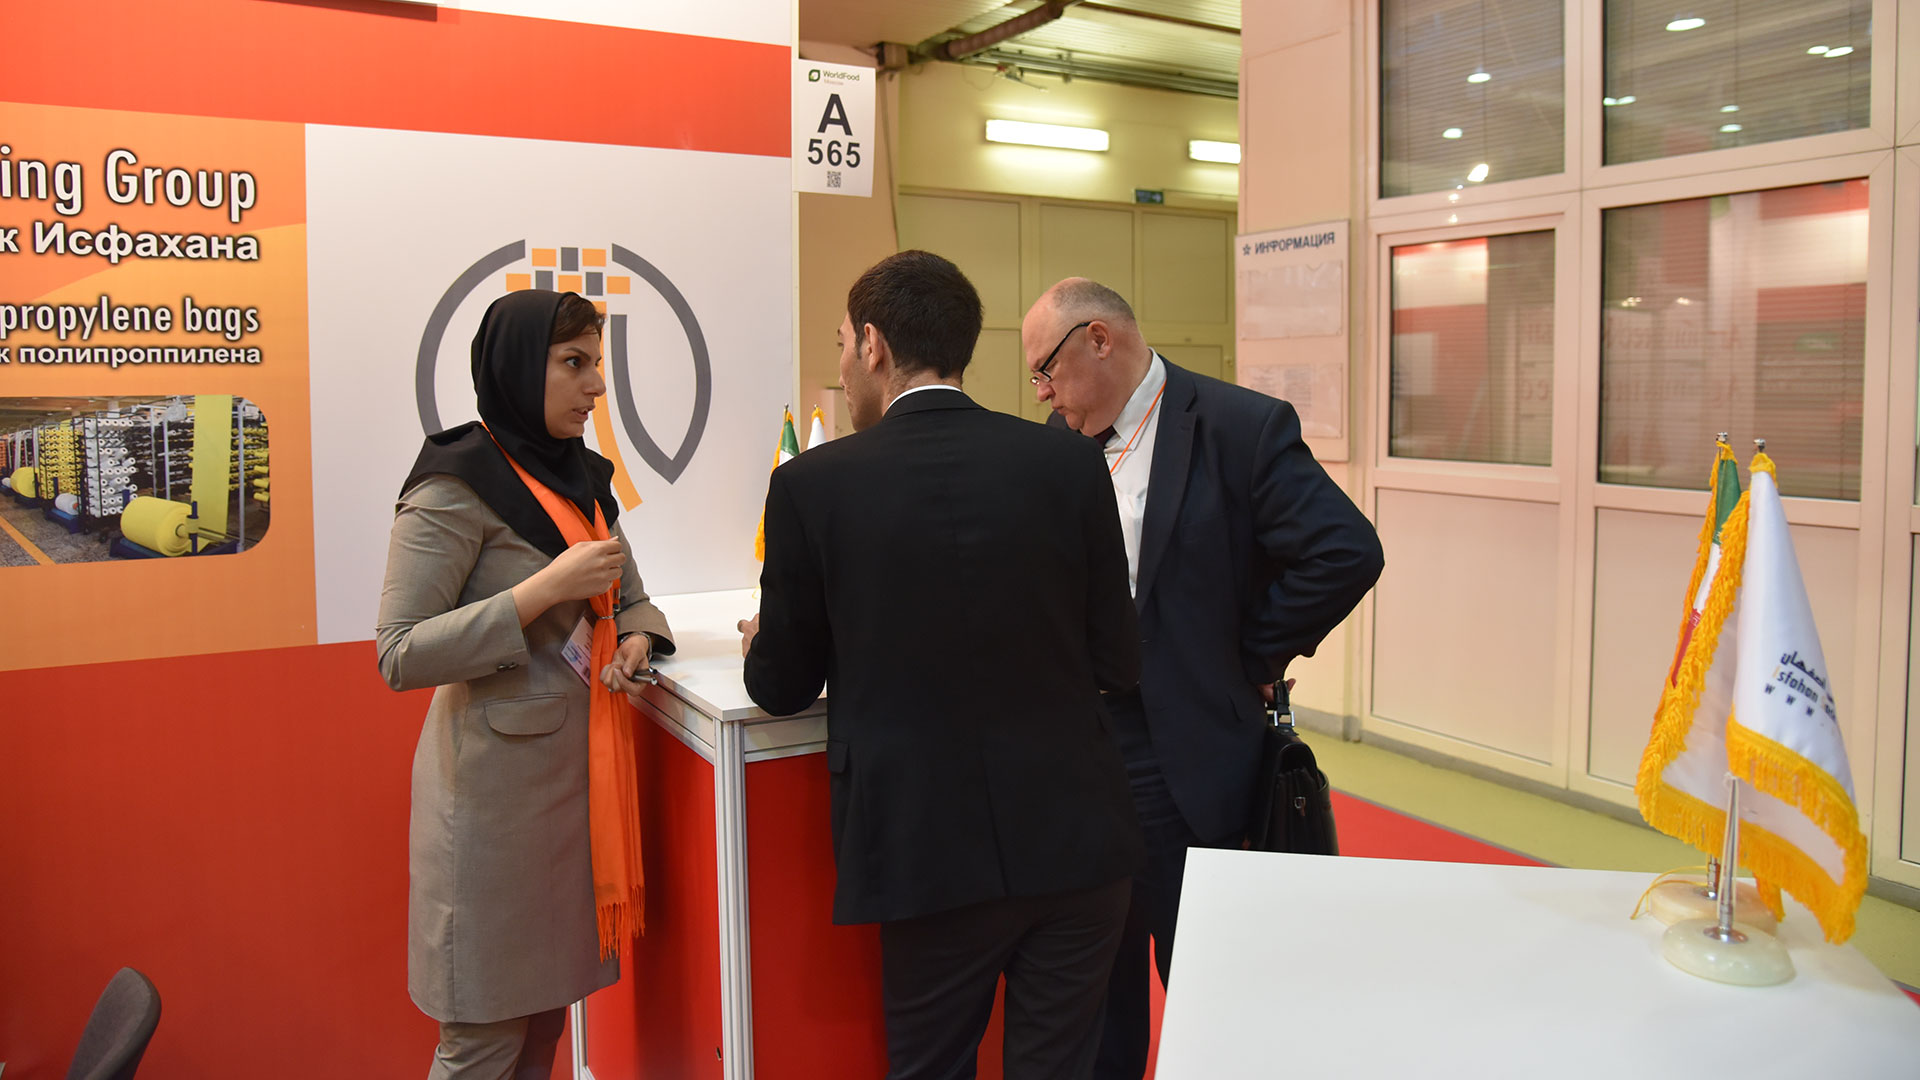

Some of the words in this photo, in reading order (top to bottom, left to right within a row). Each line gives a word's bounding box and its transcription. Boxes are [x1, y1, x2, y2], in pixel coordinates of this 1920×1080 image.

[823, 70, 860, 81] WorldFood
[817, 93, 853, 136] A
[807, 138, 861, 168] 565
[0, 145, 82, 215] ing
[106, 149, 256, 223] Group
[33, 221, 259, 264] Исфахана
[1254, 231, 1336, 255] ИНФОРМАЦИЯ
[0, 295, 172, 340] propylene
[184, 296, 260, 341] bags
[19, 347, 261, 368] полипроппилена
